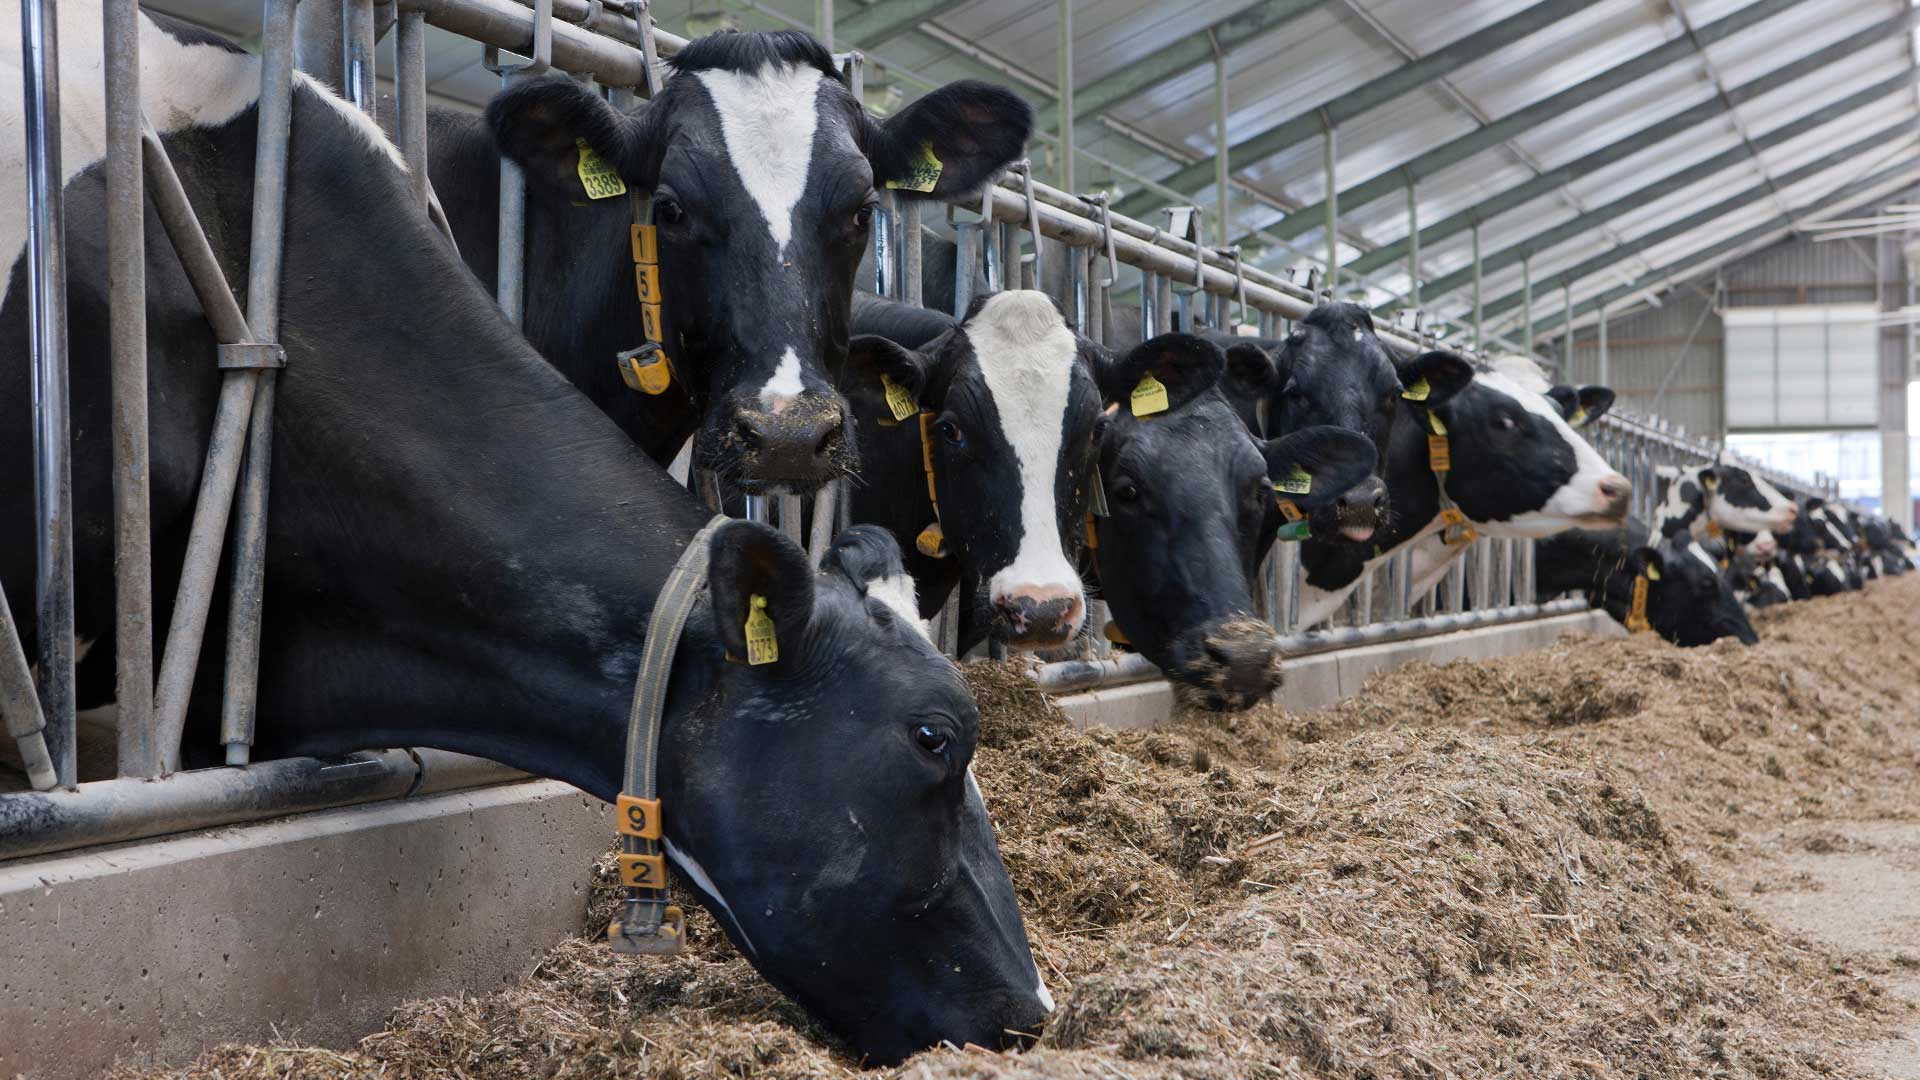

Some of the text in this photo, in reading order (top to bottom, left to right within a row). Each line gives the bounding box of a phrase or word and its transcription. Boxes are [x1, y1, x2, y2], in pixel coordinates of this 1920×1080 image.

[585, 173, 621, 197] 3389
[637, 230, 644, 258] 1
[640, 271, 649, 297] 5
[894, 396, 917, 419] 407
[627, 805, 646, 832] 9
[631, 861, 652, 884] 2
